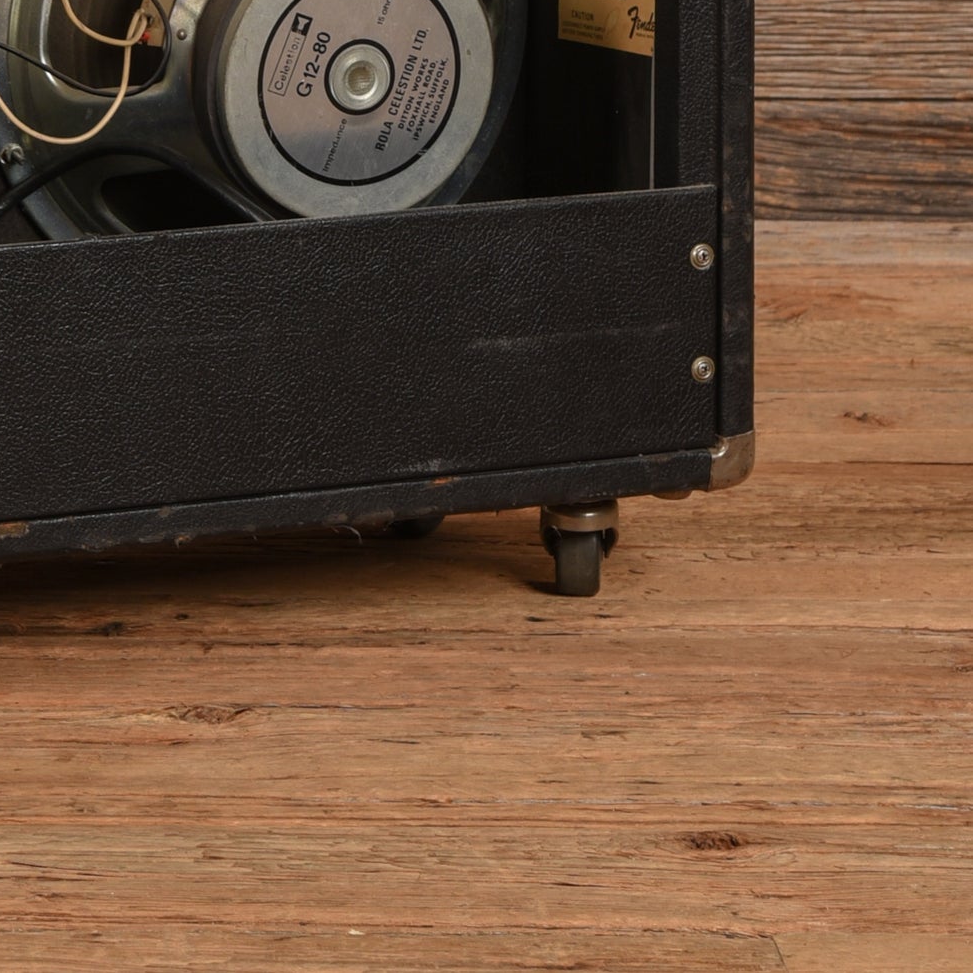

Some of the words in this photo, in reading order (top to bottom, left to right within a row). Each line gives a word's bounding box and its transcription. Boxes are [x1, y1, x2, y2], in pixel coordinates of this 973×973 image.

[377, 16, 385, 25] 15
[274, 35, 302, 91] Celestion
[375, 121, 393, 151] ROLA
[388, 55, 418, 116] CELESTION
[412, 28, 429, 52] LTD.
[430, 58, 449, 99] SUFFOLK,
[398, 98, 414, 130] DITTON
[412, 58, 429, 96] WORKS
[407, 90, 426, 133] FOXHALL
[425, 60, 439, 89] ROAD,
[430, 79, 449, 124] ENGLAND
[323, 119, 347, 173] Impedance
